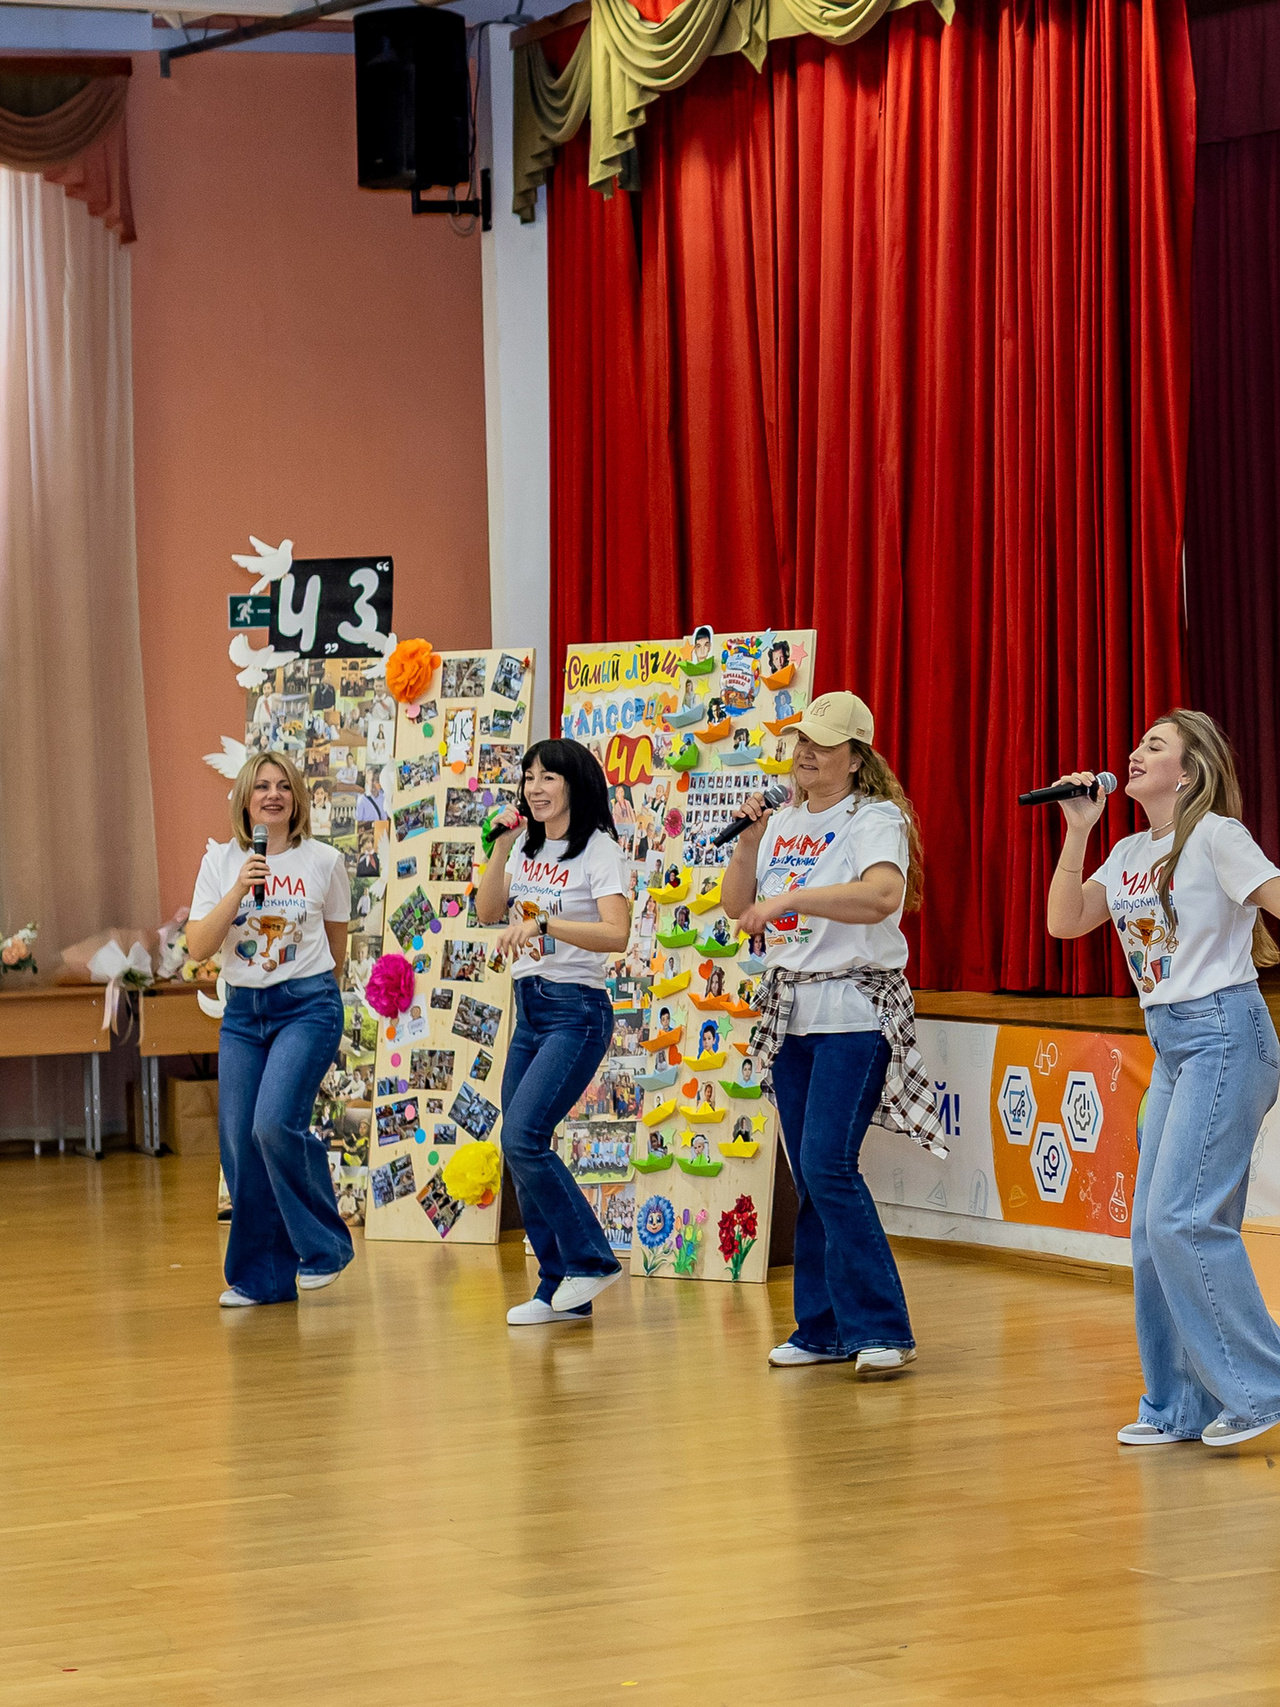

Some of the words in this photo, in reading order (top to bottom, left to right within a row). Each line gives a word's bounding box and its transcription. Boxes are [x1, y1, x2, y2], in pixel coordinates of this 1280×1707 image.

[567, 654, 622, 690] Самый
[625, 650, 682, 683] лучш
[563, 700, 635, 740] КЛАСС
[518, 859, 570, 888] МАМА
[239, 898, 306, 910] ыпскника
[1111, 894, 1175, 914] выпускниа
